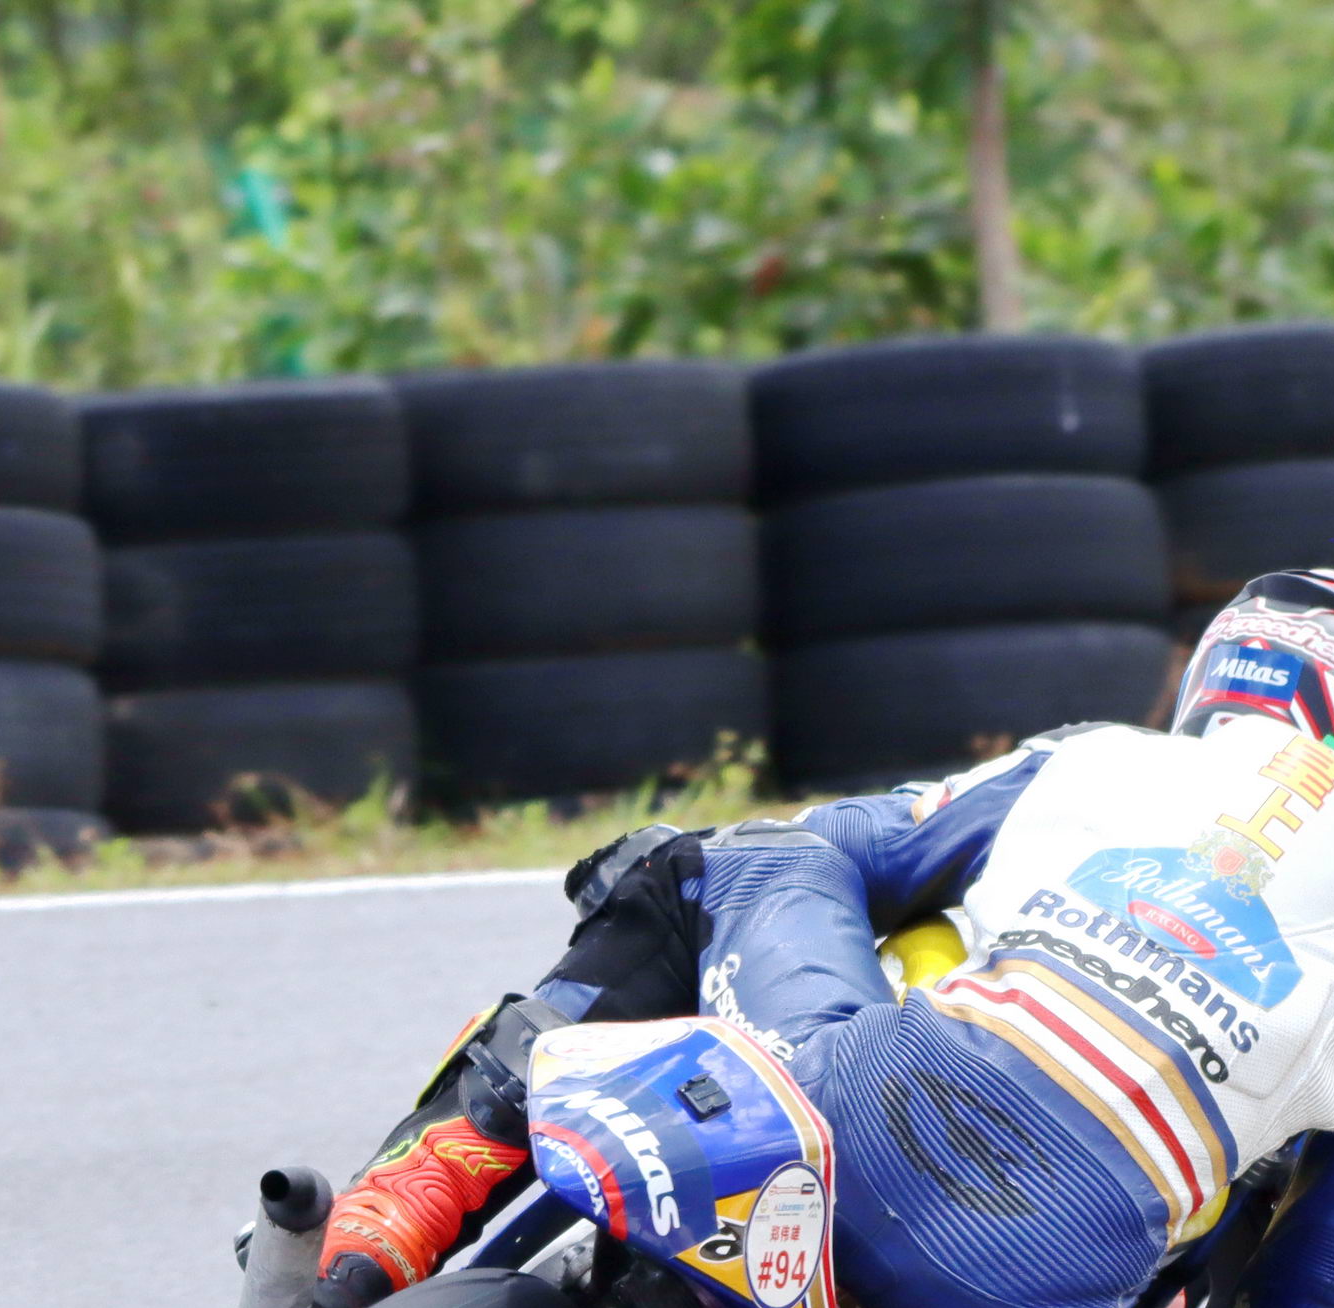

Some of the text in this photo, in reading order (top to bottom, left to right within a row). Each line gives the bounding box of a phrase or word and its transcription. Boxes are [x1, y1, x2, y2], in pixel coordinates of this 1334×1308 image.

[1211, 657, 1289, 687] Mitas
[1100, 857, 1276, 981] Rothmans
[1145, 909, 1200, 946] RACING
[989, 929, 1229, 1084] speedhero
[1018, 888, 1259, 1053] Rothmans
[539, 1136, 605, 1216] HONDA
[541, 1089, 681, 1237] Mitas
[757, 1250, 806, 1290] #94
